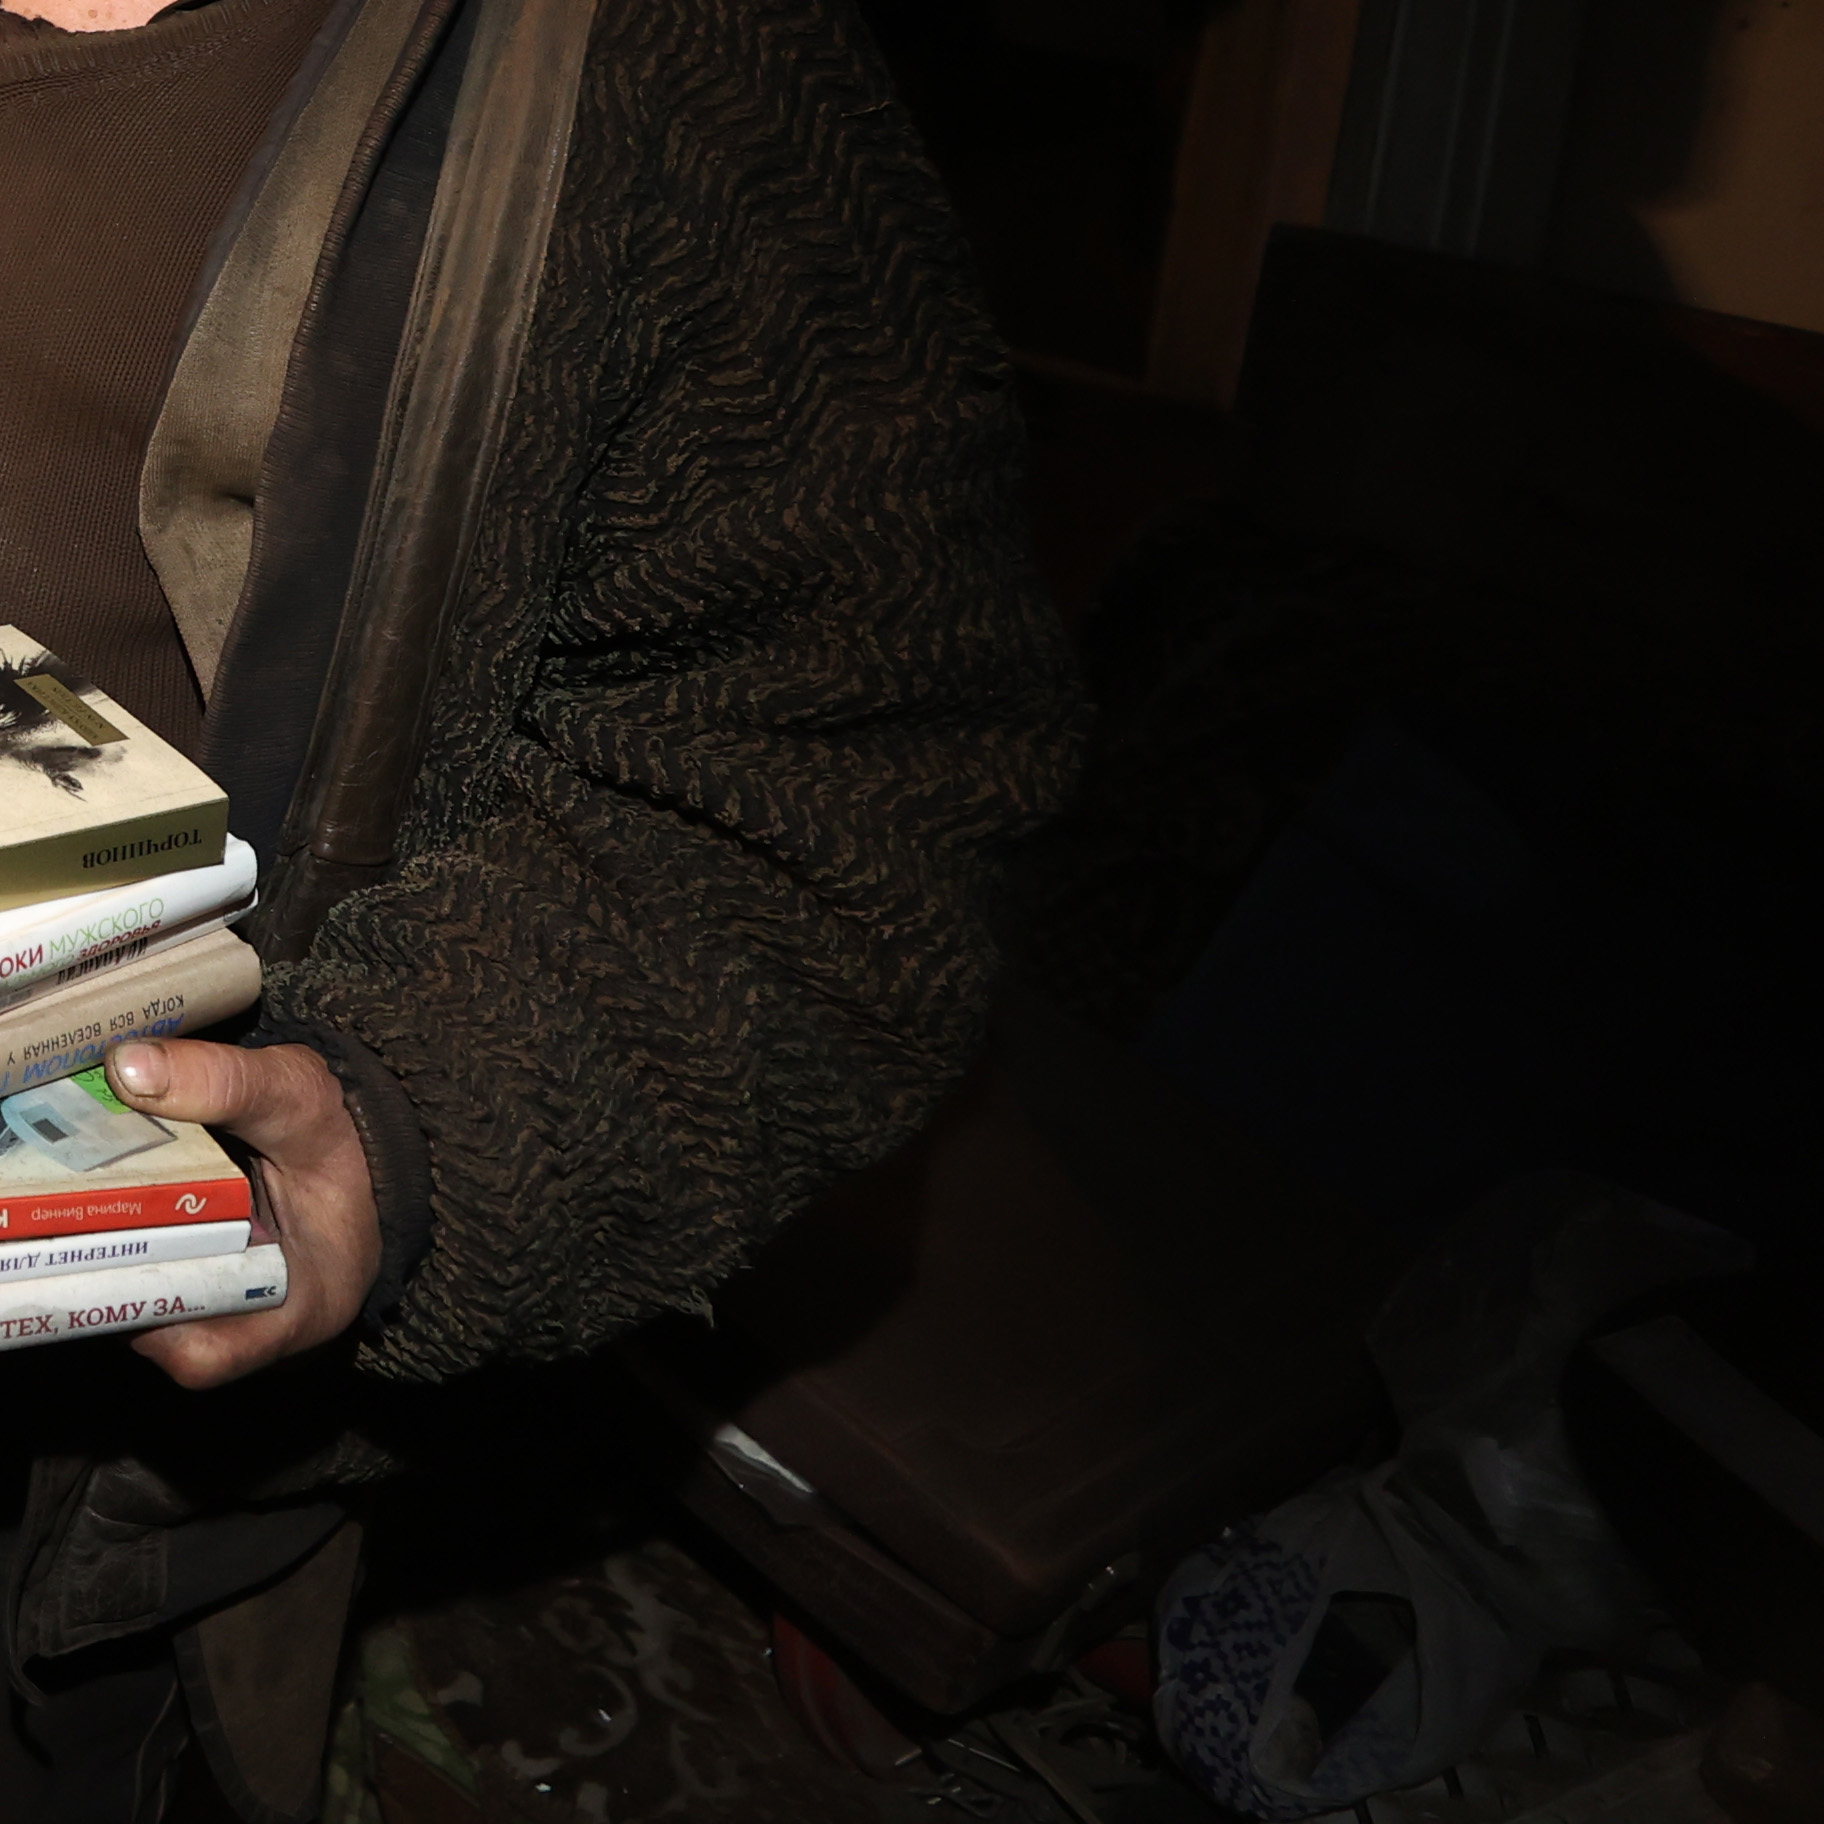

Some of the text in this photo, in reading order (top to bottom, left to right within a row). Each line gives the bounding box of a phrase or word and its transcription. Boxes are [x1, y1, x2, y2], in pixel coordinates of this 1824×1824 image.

[82, 828, 202, 869] ТОРЧИНОВ
[49, 898, 165, 957] МУЖСКОГО
[141, 993, 185, 1020] КОГДА
[109, 1011, 135, 1032] ВСЯ
[23, 1024, 102, 1058] ВСЕЛЕННАЯ
[7, 1053, 16, 1066] У
[31, 1206, 84, 1222] Виннер
[87, 1201, 142, 1219] Марина
[0, 1254, 41, 1273] ДЛЯ
[44, 1241, 149, 1267] ИНТЕРНЕТ
[67, 1300, 146, 1330] КОМУ
[152, 1295, 206, 1317] ЗА...
